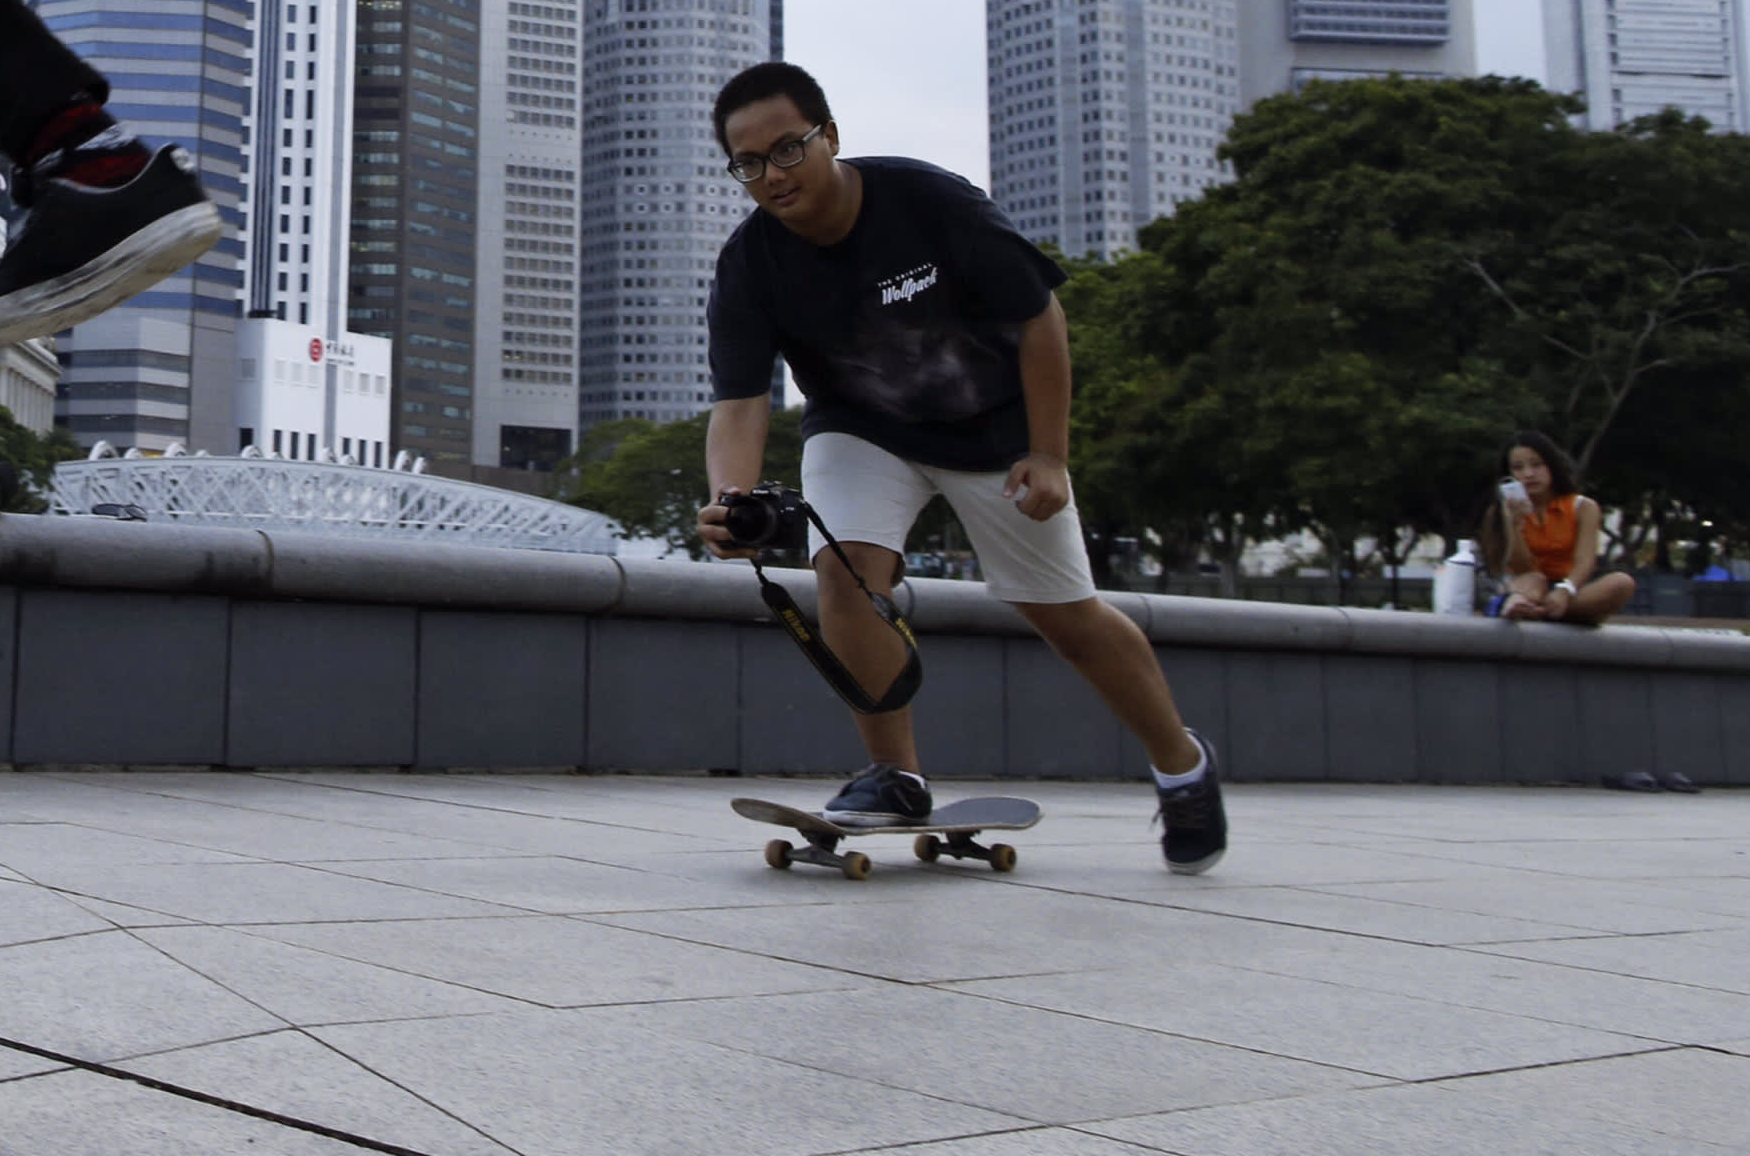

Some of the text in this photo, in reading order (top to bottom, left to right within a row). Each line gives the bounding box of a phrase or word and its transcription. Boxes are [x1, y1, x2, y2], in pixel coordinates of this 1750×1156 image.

[877, 262, 933, 287] THE ORIGINAL
[881, 266, 938, 305] Wolfpack
